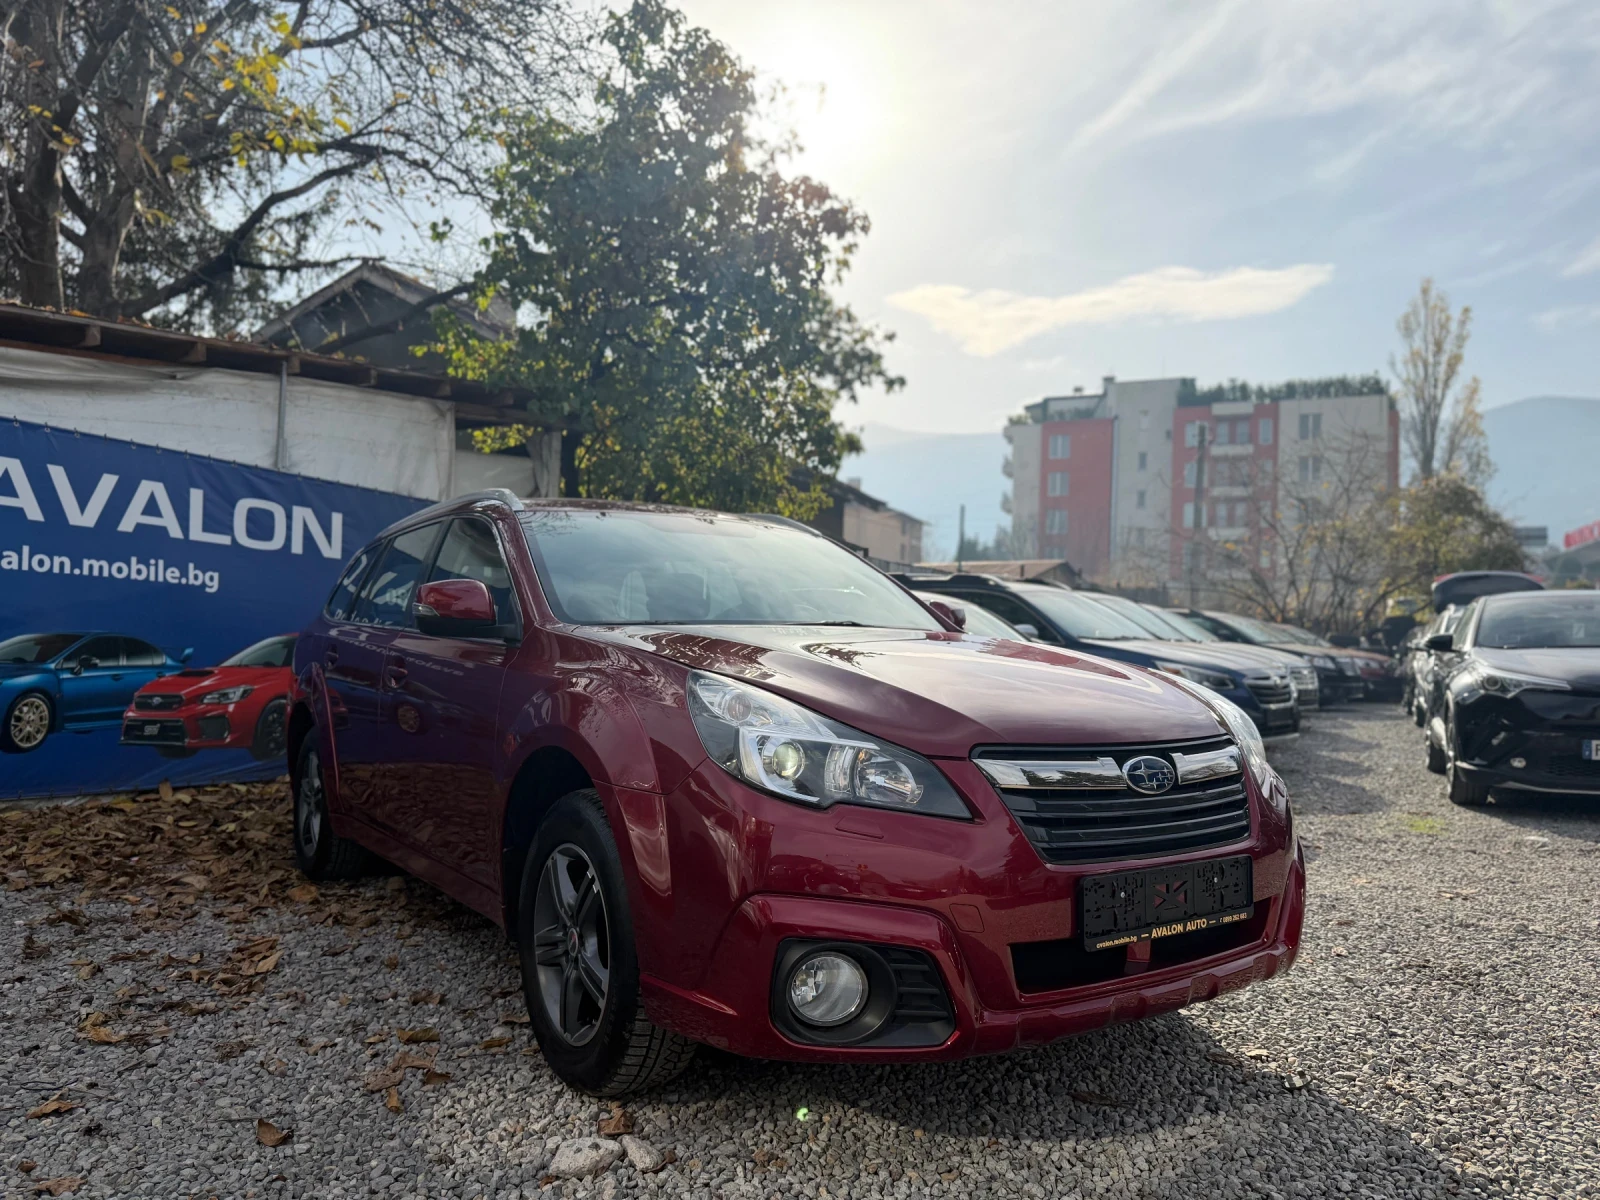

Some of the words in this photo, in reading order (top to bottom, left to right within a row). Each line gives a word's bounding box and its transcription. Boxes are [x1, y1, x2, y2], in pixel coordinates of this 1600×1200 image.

[0, 456, 343, 560] AVALON
[0, 545, 220, 593] alon.mobile.bg
[1151, 923, 1184, 938] AVALON
[1186, 918, 1207, 931] AUTO
